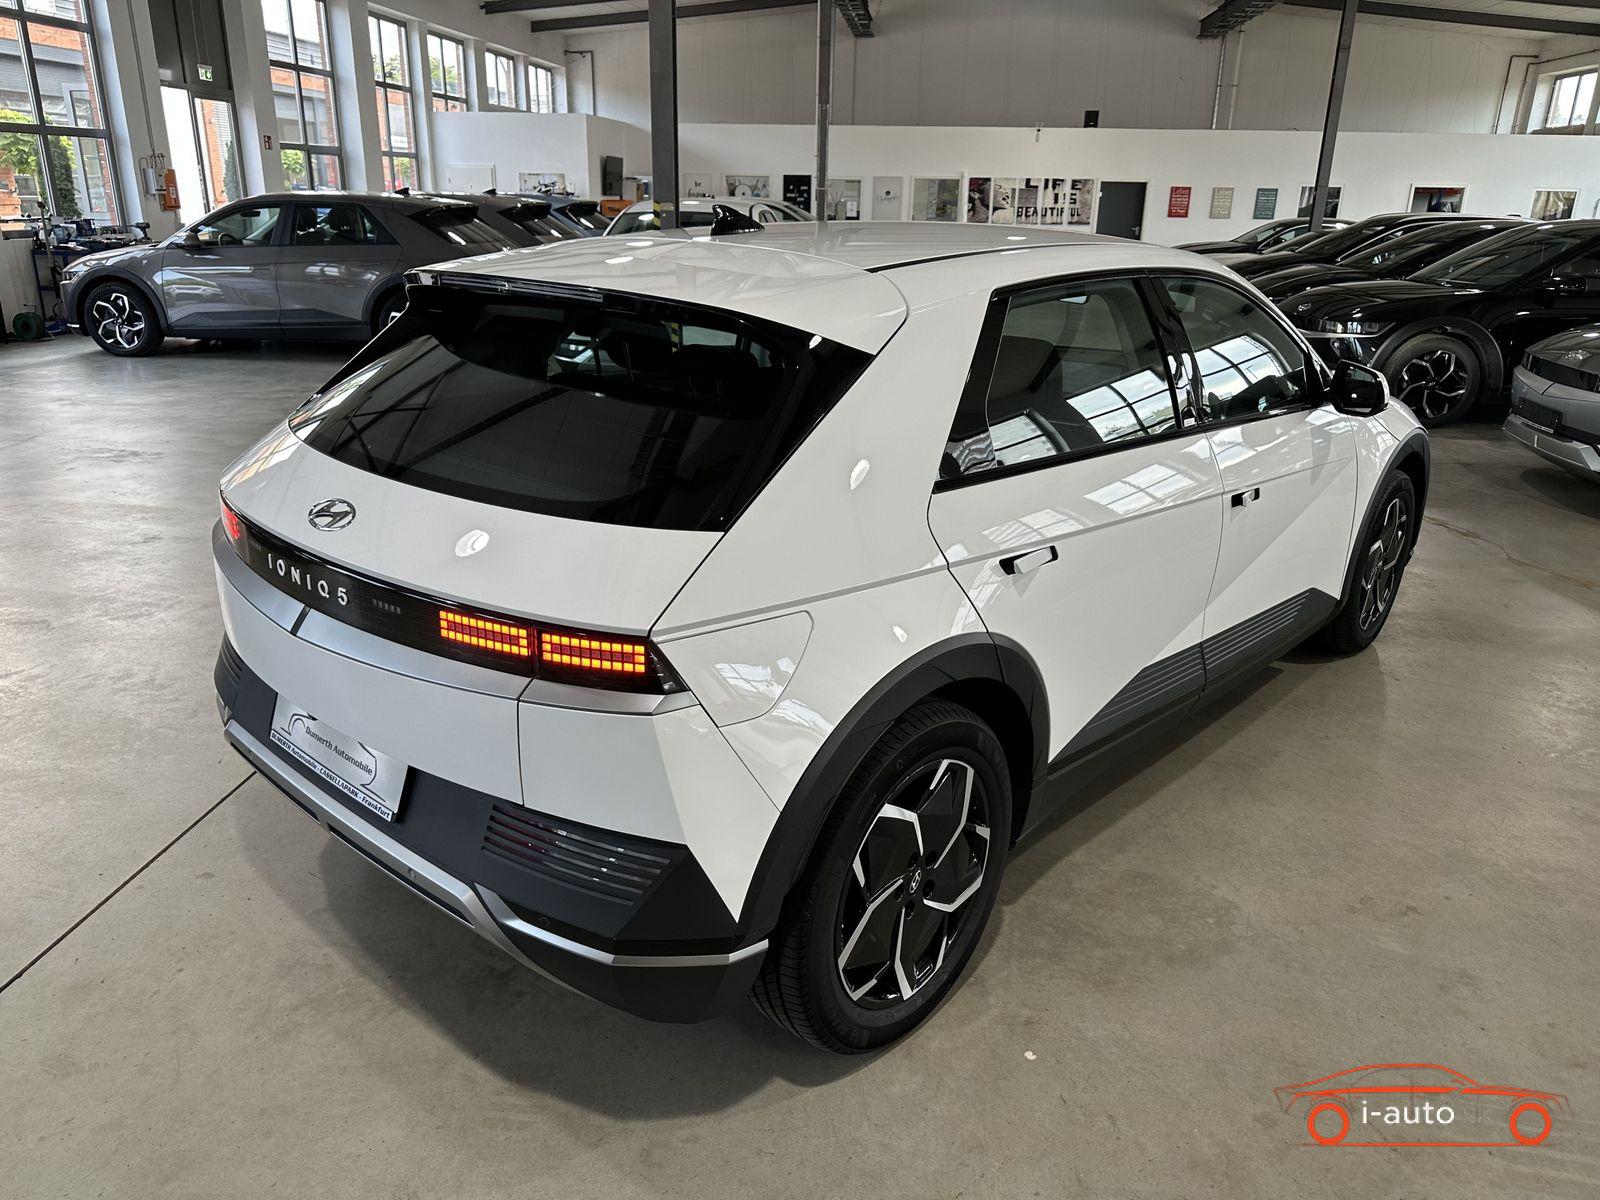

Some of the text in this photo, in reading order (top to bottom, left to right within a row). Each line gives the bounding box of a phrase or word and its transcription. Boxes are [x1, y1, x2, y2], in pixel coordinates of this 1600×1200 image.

[1025, 178, 1082, 190] LIFE
[1054, 192, 1077, 204] IS
[1017, 206, 1081, 218] BEAUTIFUL
[267, 553, 349, 606] IONIQ 5
[271, 732, 292, 752] DUMERTH
[290, 746, 318, 770] Automobile
[319, 767, 359, 799] CASSELLAPARK
[305, 726, 374, 776] Dumerth Automobile
